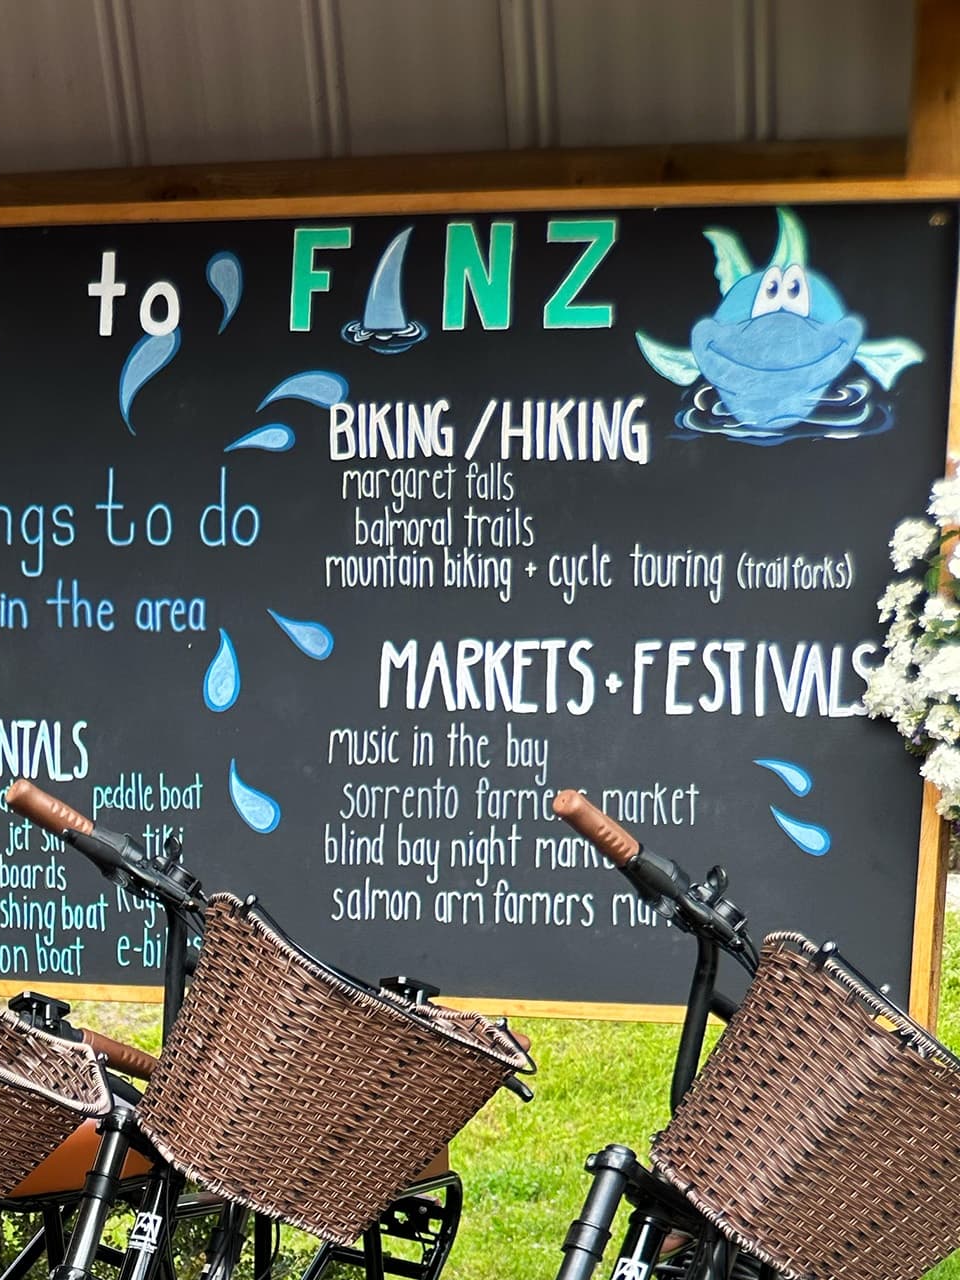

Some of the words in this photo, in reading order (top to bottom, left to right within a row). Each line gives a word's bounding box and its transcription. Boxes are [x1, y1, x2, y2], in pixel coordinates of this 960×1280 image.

[87, 250, 182, 337] to
[329, 400, 455, 462] BIKING
[95, 467, 173, 547] to
[199, 466, 261, 547] do
[342, 463, 456, 513] margaret
[465, 462, 515, 501] falls
[355, 507, 452, 548] balmoral
[463, 506, 535, 549] trails
[325, 546, 434, 589] mountain
[443, 547, 512, 603] biking
[548, 543, 613, 605] cycle
[630, 543, 724, 605] touring
[0, 593, 29, 630] in
[46, 578, 116, 632] the
[135, 597, 207, 632] area
[378, 639, 595, 716] MARKETS
[632, 639, 876, 718] FESTIVALS
[327, 724, 400, 766] music
[412, 726, 434, 768] in
[447, 722, 491, 769] the
[506, 722, 549, 786] bay
[160, 772, 203, 812] boat
[339, 776, 460, 821] sorrento
[475, 776, 587, 822] farme
[601, 782, 701, 827] market
[5, 817, 34, 857] jet
[324, 823, 384, 867] blind
[398, 824, 440, 885] bay
[450, 823, 523, 888] night
[0, 853, 67, 892] boards
[61, 893, 109, 931] boat
[330, 877, 421, 922] salmon
[434, 890, 485, 926] arm
[492, 878, 595, 928] farmers
[35, 933, 85, 976] boat
[116, 927, 204, 970] e-bi
